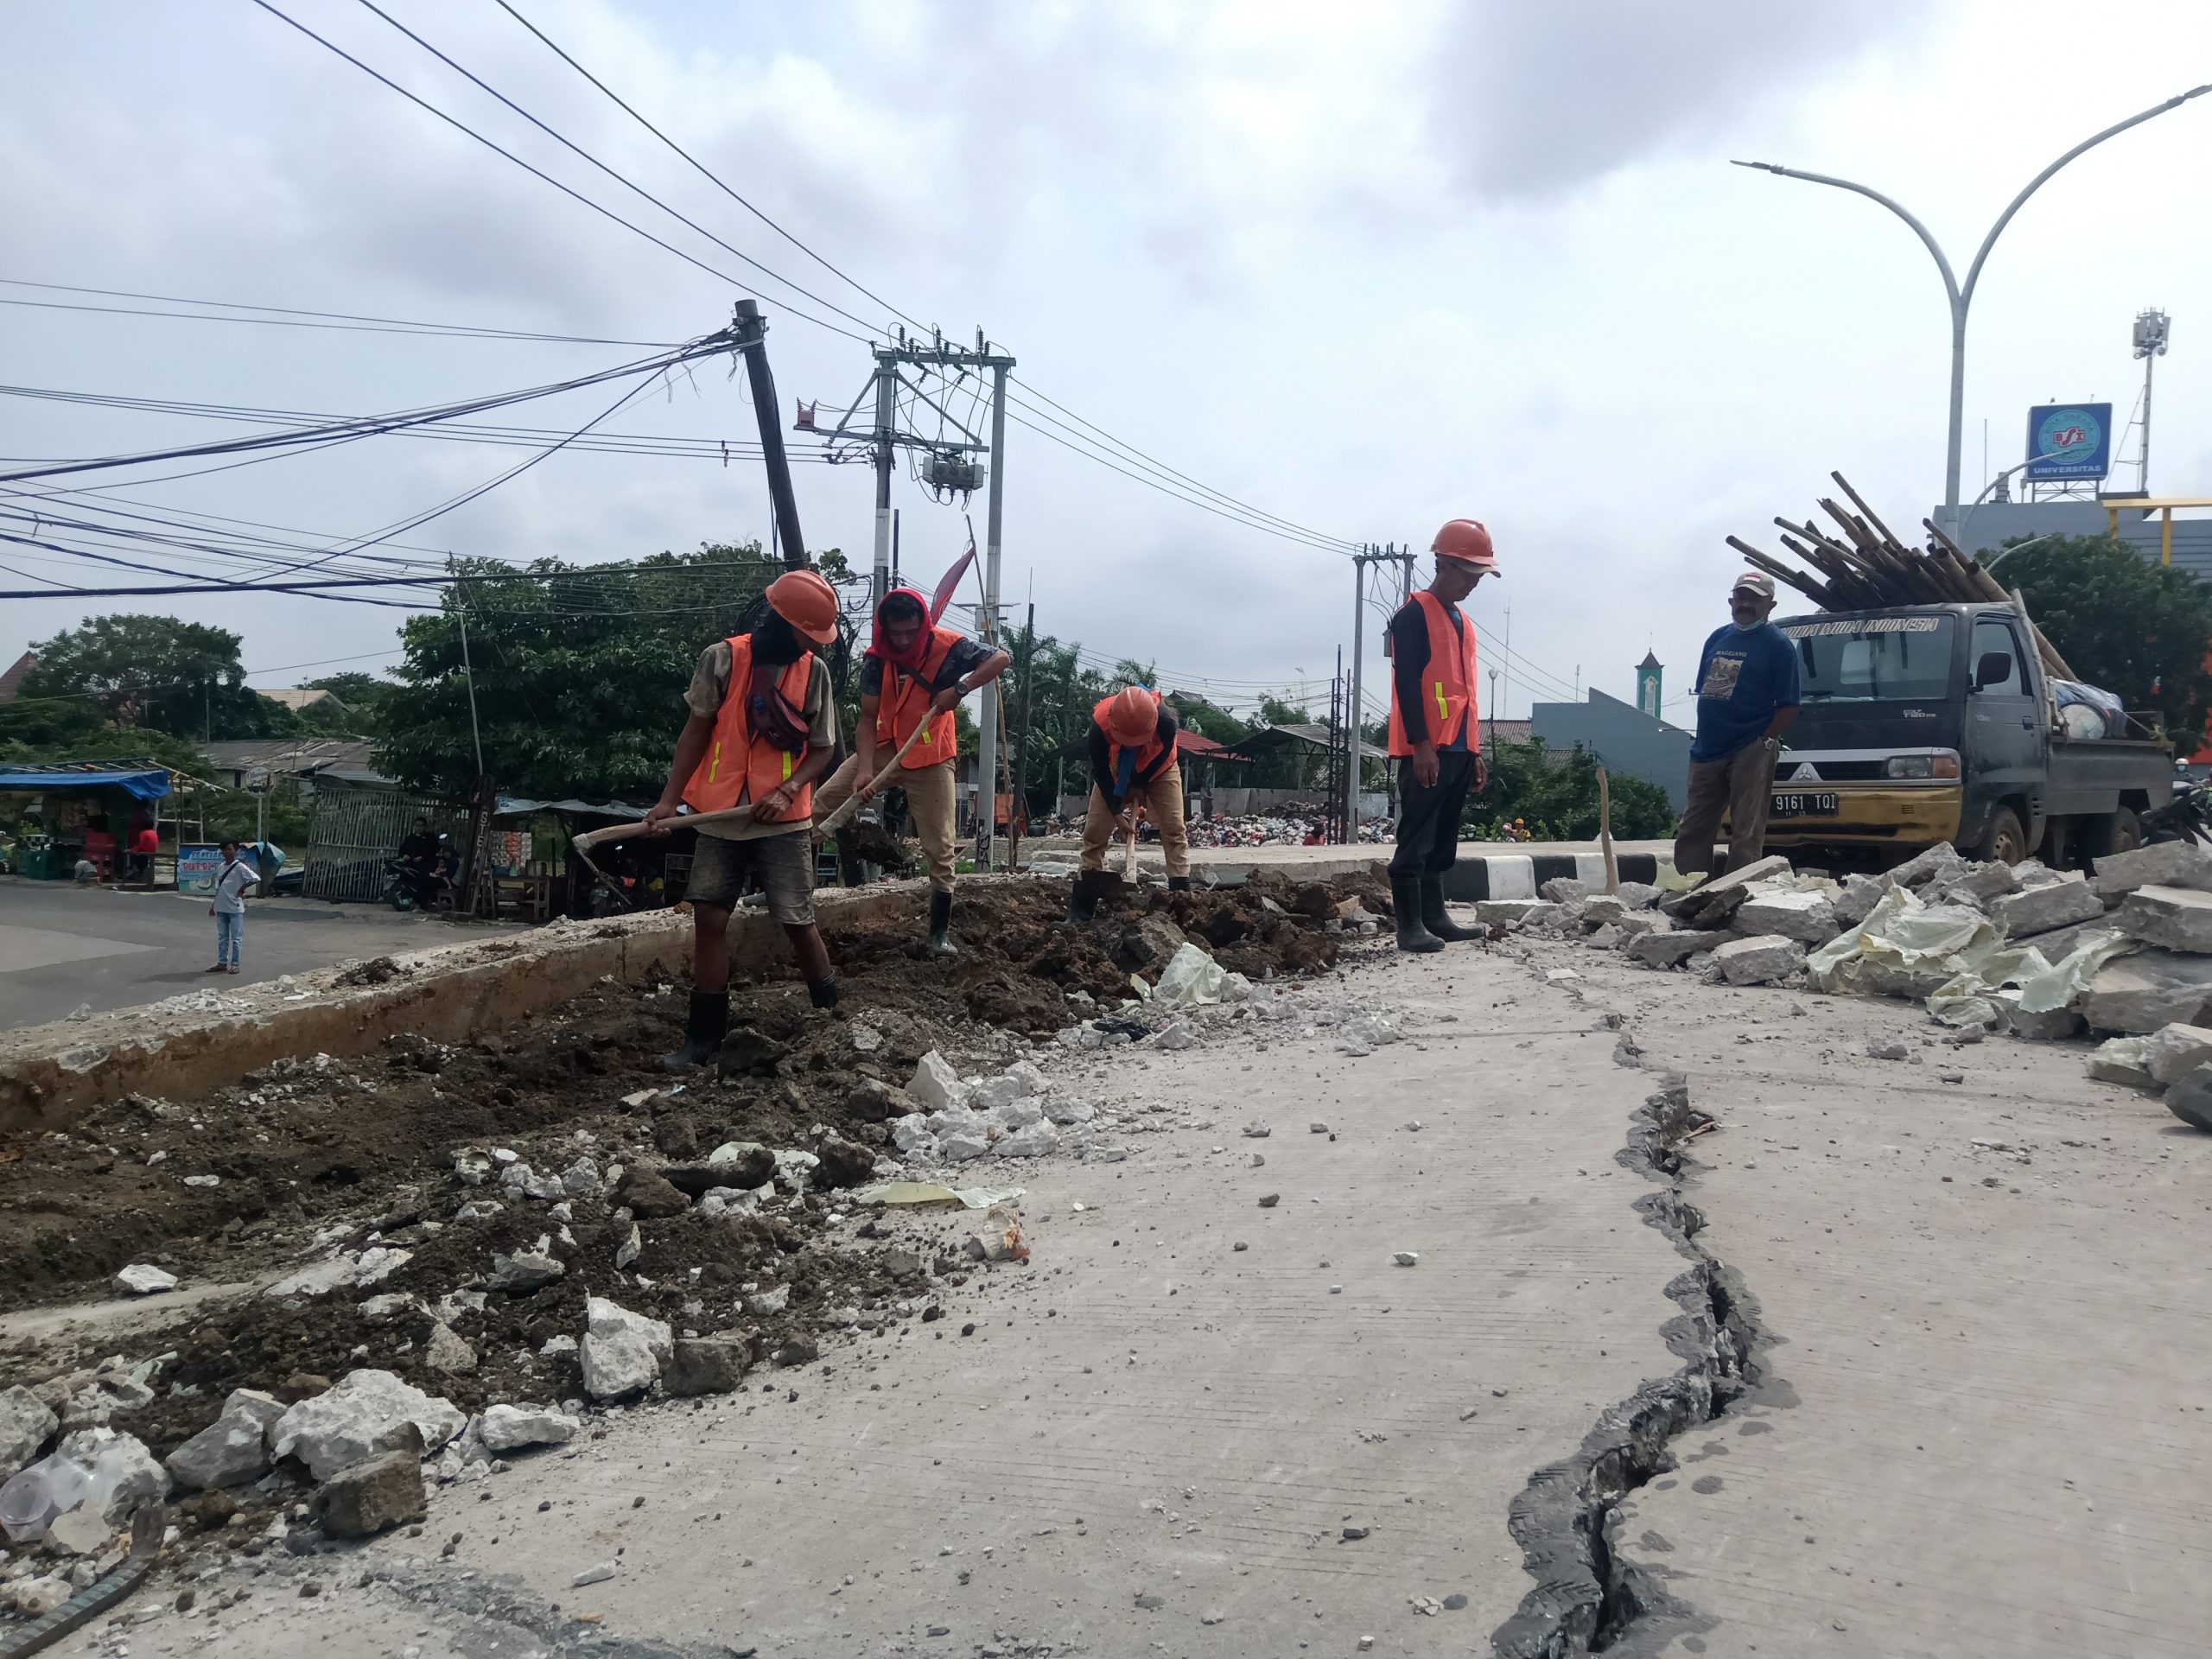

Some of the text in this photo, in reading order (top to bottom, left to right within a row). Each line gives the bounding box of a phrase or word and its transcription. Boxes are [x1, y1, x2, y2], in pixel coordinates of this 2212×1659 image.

[2055, 427, 2084, 446] BSI
[2033, 465, 2101, 474] UNIVERSITAS
[1819, 620, 1862, 636] MUDA
[1862, 618, 1940, 632] INDONESIA
[1776, 794, 1836, 810] 9161 TQI
